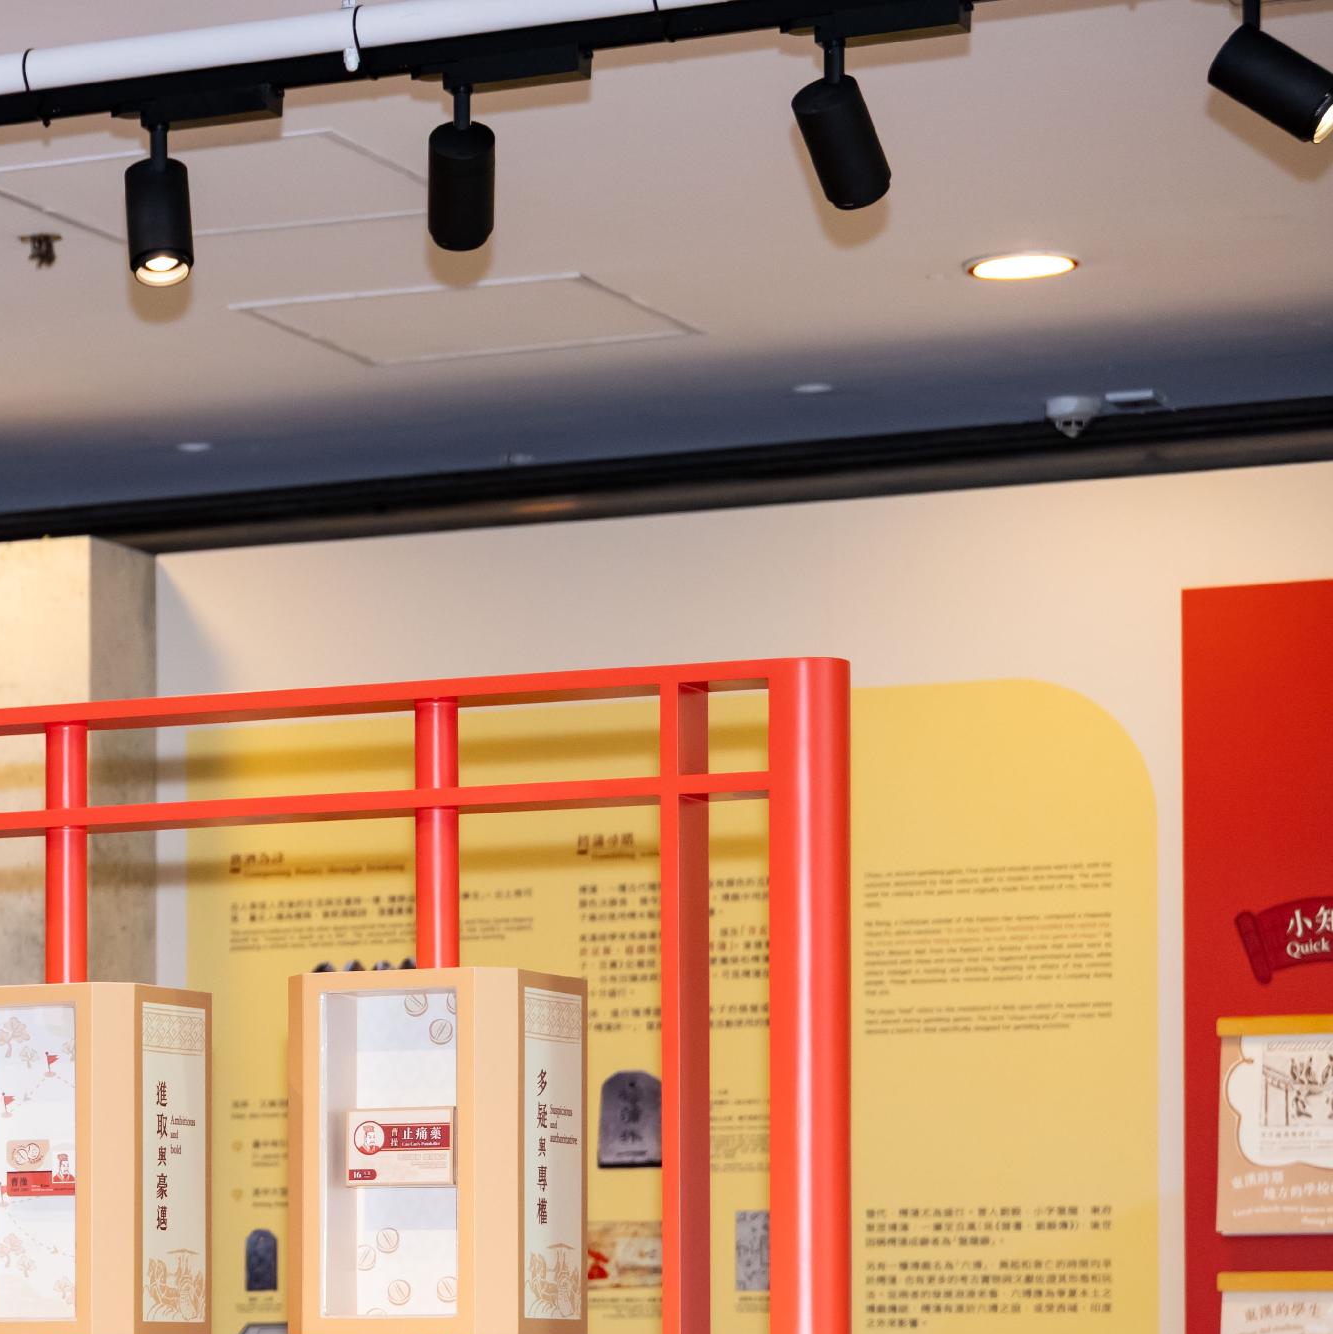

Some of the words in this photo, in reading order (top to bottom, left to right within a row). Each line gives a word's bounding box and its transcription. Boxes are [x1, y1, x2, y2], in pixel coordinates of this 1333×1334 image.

[1286, 937, 1330, 960] Quick
[550, 1103, 573, 1118] Suspicious
[170, 1115, 196, 1127] Ambitious
[550, 1121, 558, 1129] and
[170, 1131, 179, 1139] and
[402, 1126, 442, 1140] 止痛藥
[170, 1145, 182, 1155] bold
[536, 1068, 548, 1225] 多疑與專權
[156, 1080, 168, 1231] 進取與豪邁
[353, 1171, 363, 1179] 16
